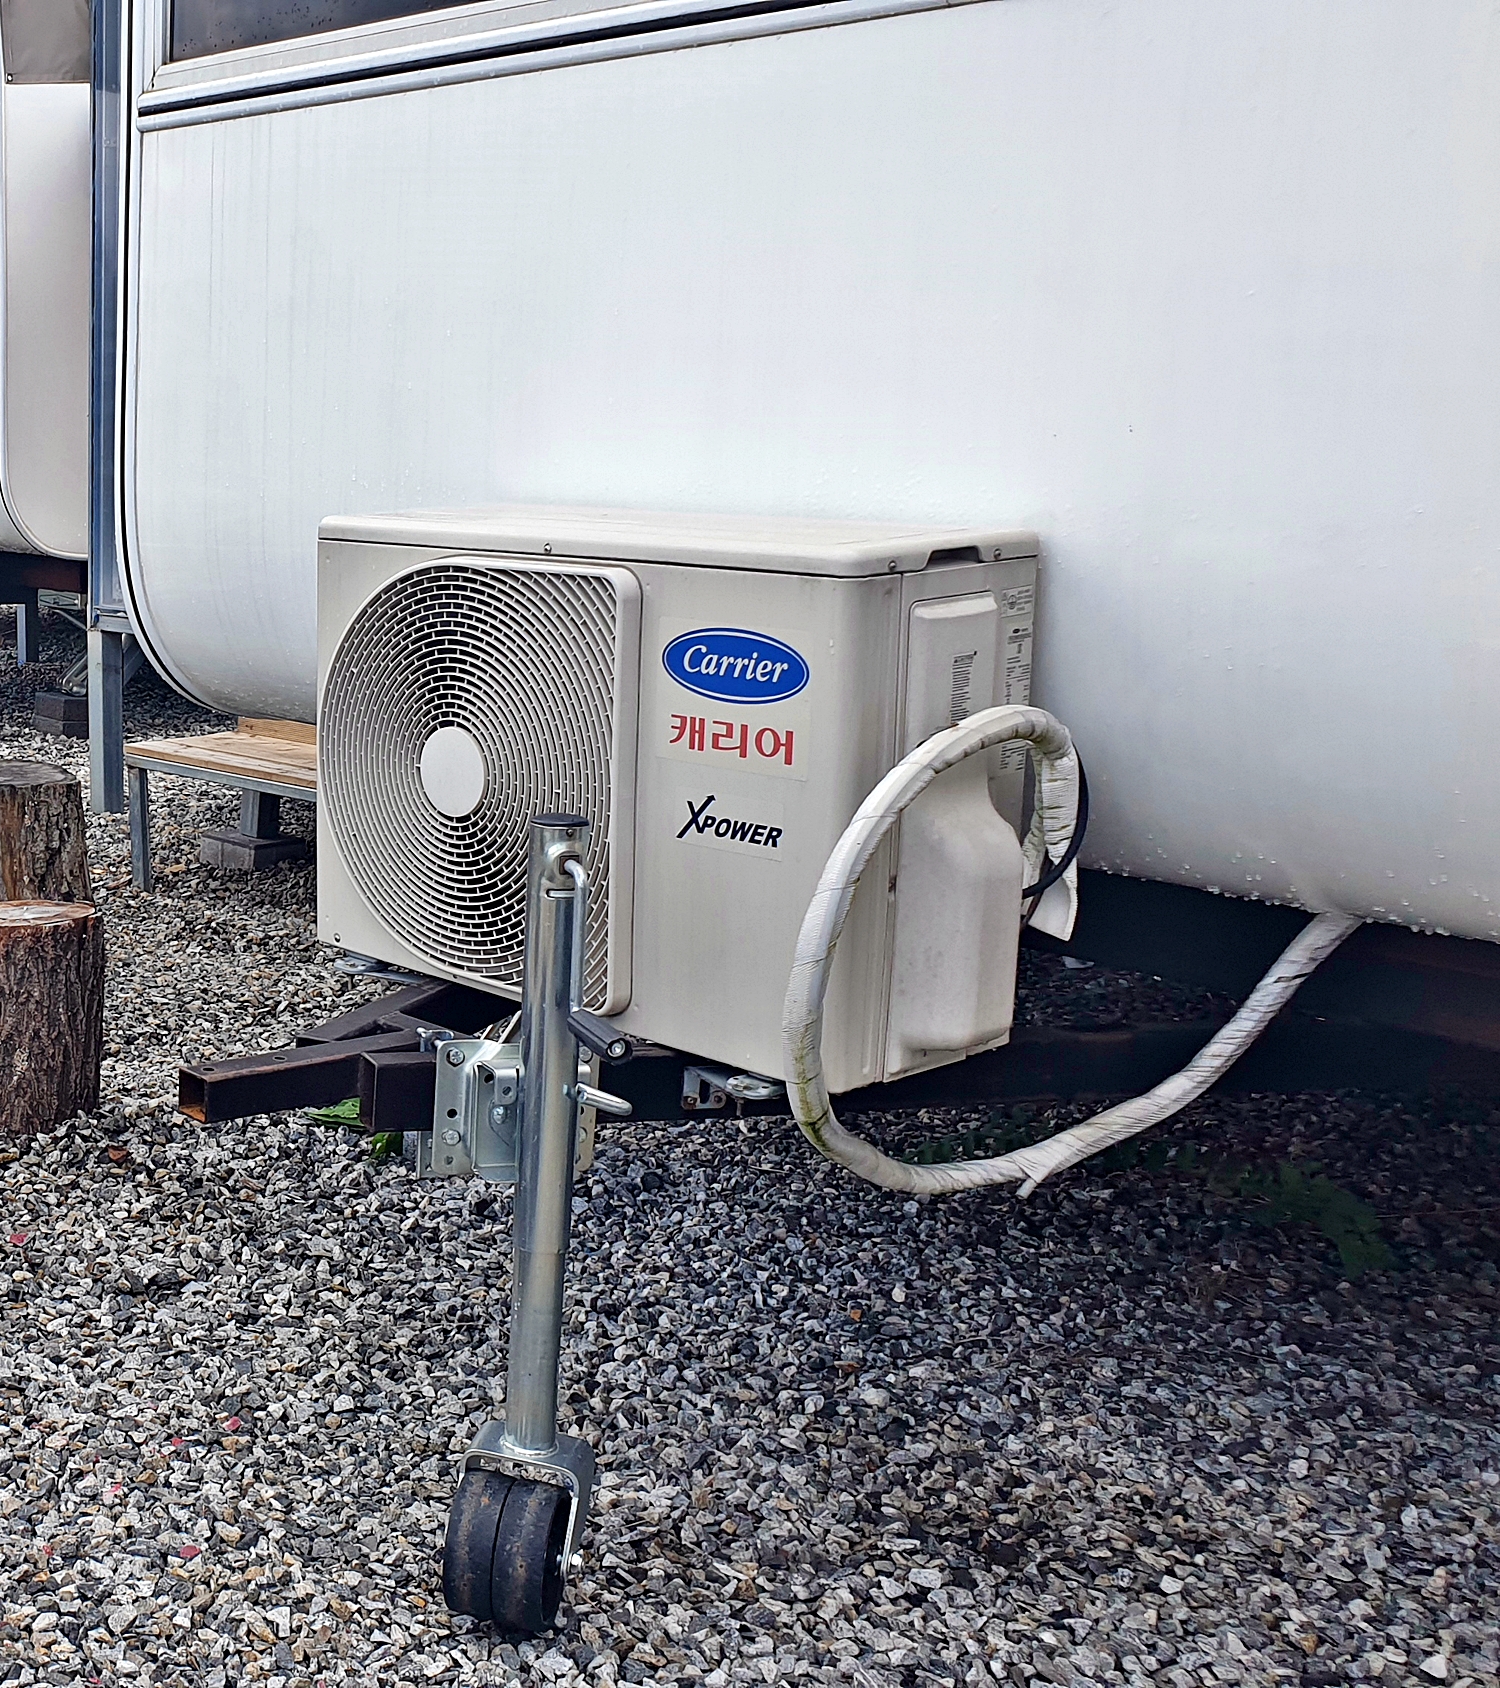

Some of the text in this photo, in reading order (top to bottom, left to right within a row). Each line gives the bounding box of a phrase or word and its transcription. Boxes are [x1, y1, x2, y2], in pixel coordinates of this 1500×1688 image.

[683, 645, 789, 684] Carrier
[669, 714, 794, 766] 캐리어
[676, 795, 783, 849] XPOWER
